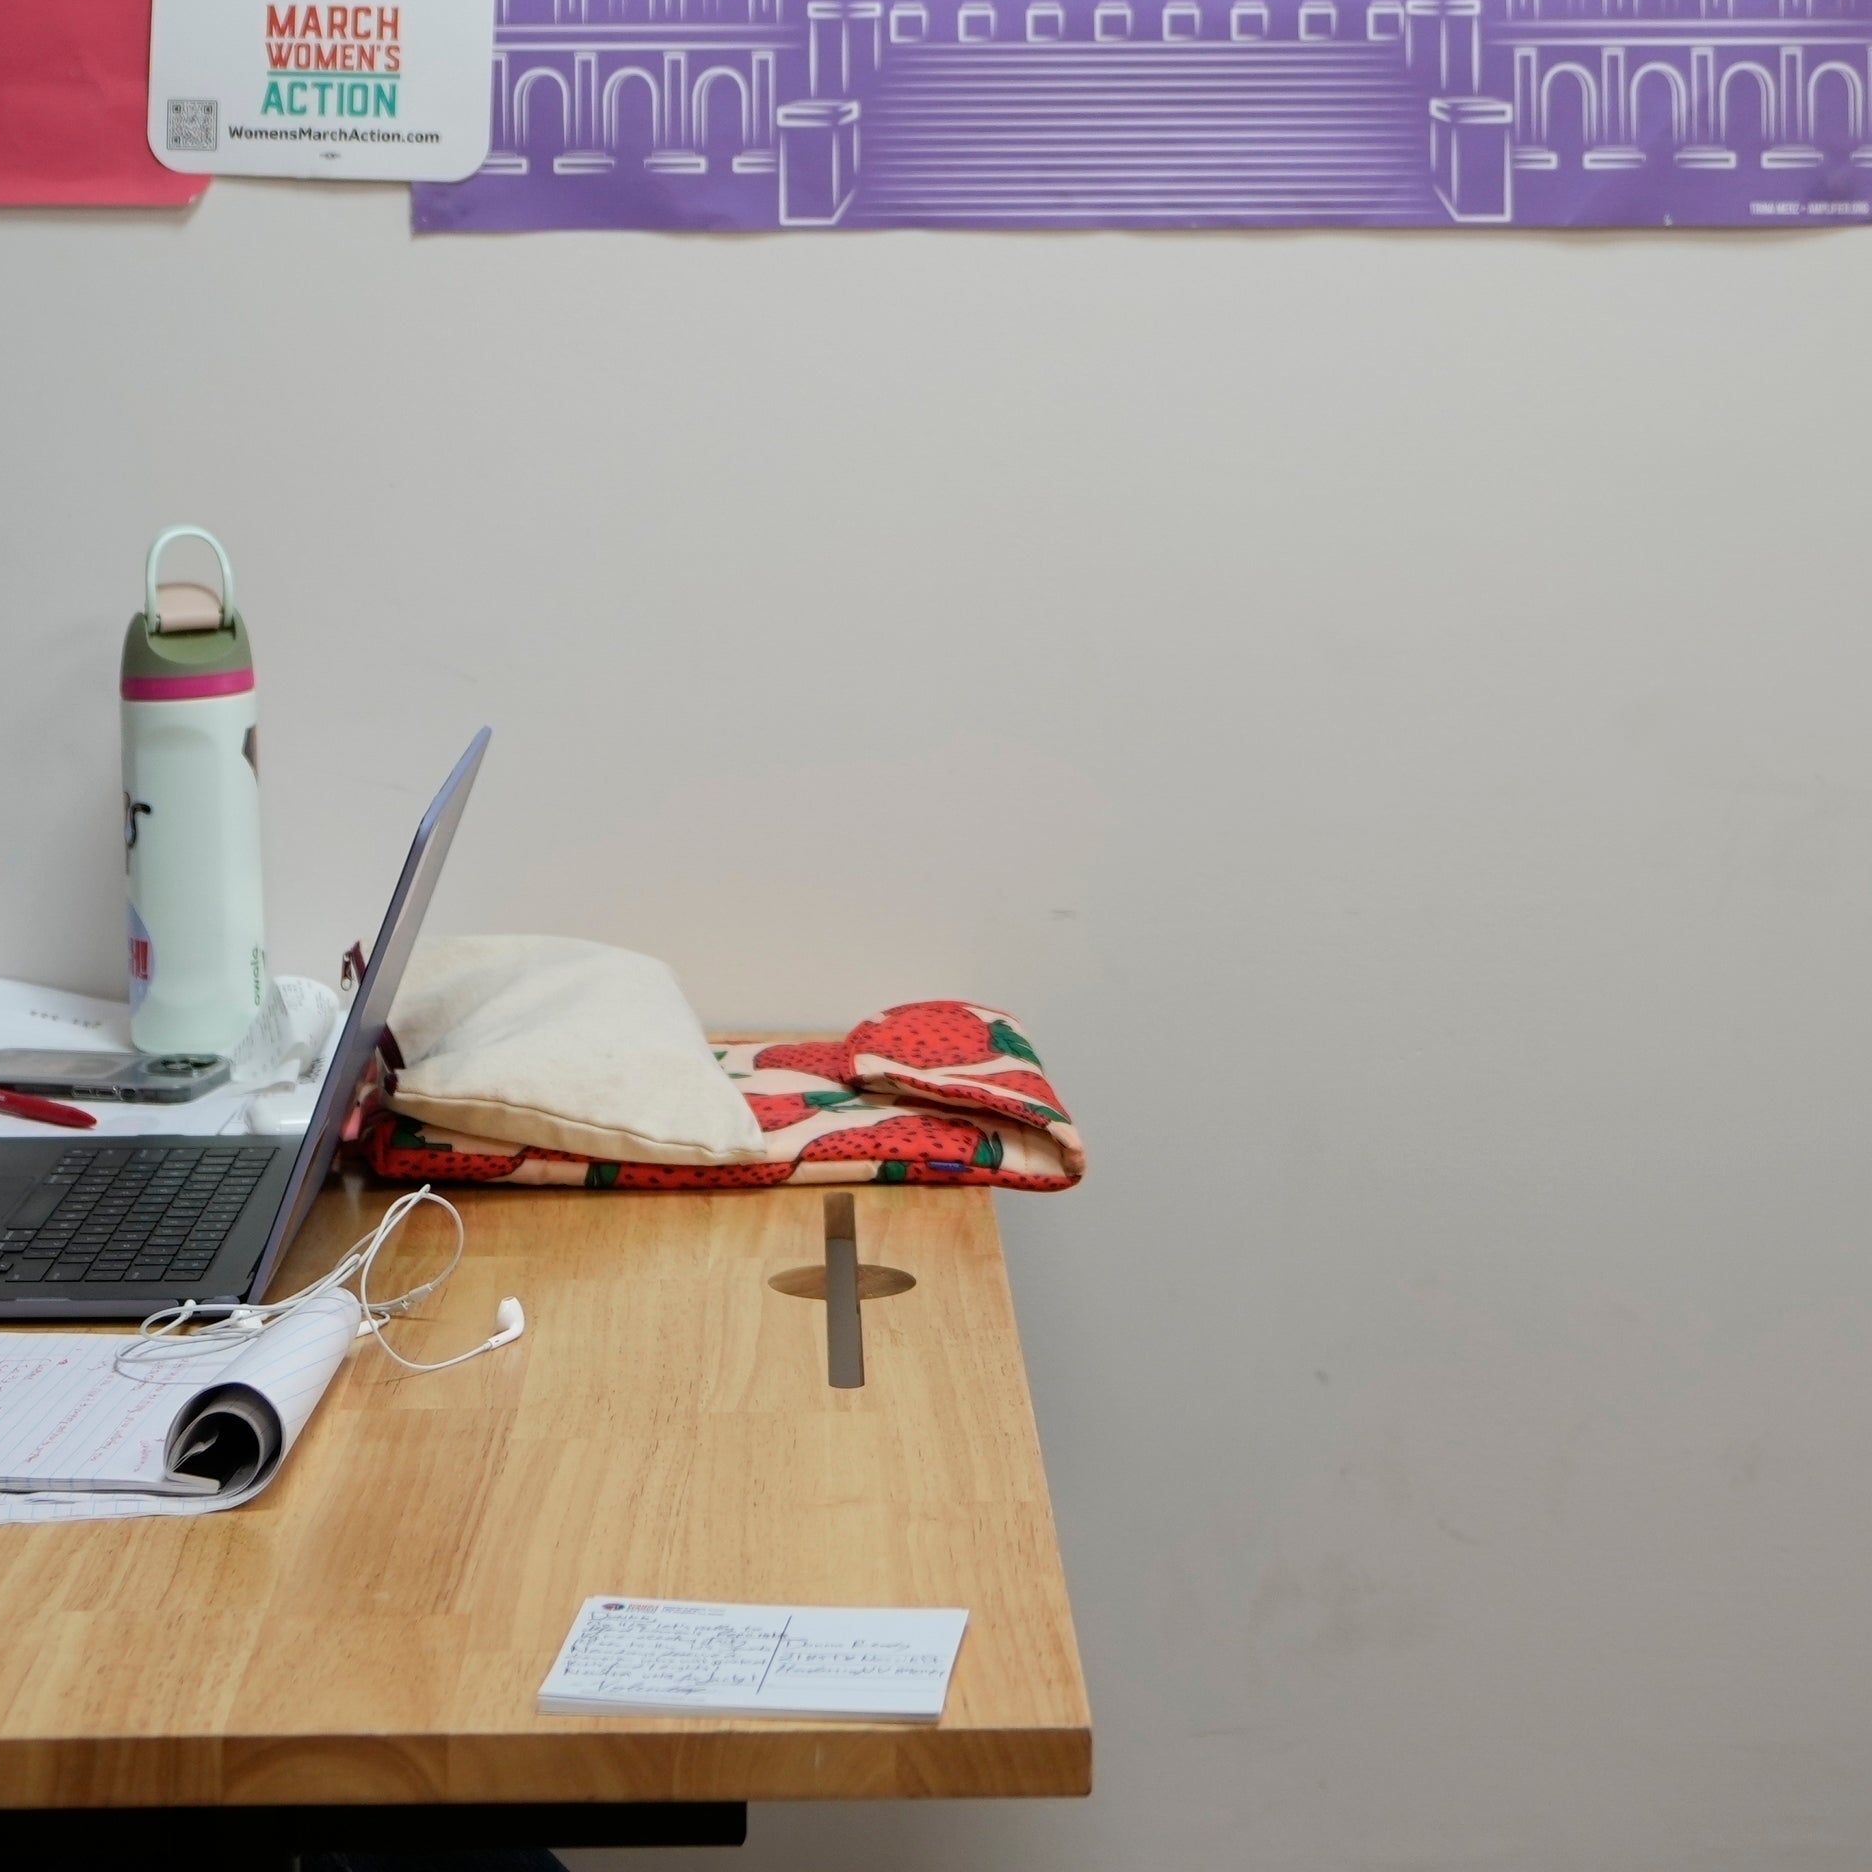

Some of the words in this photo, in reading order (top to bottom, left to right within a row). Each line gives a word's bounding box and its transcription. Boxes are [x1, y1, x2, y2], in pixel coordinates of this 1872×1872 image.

[265, 3, 400, 42] MARCH
[265, 42, 401, 72] WOMEN'S
[260, 80, 398, 119] ACTION
[228, 125, 441, 145] WomensMarchAction.com
